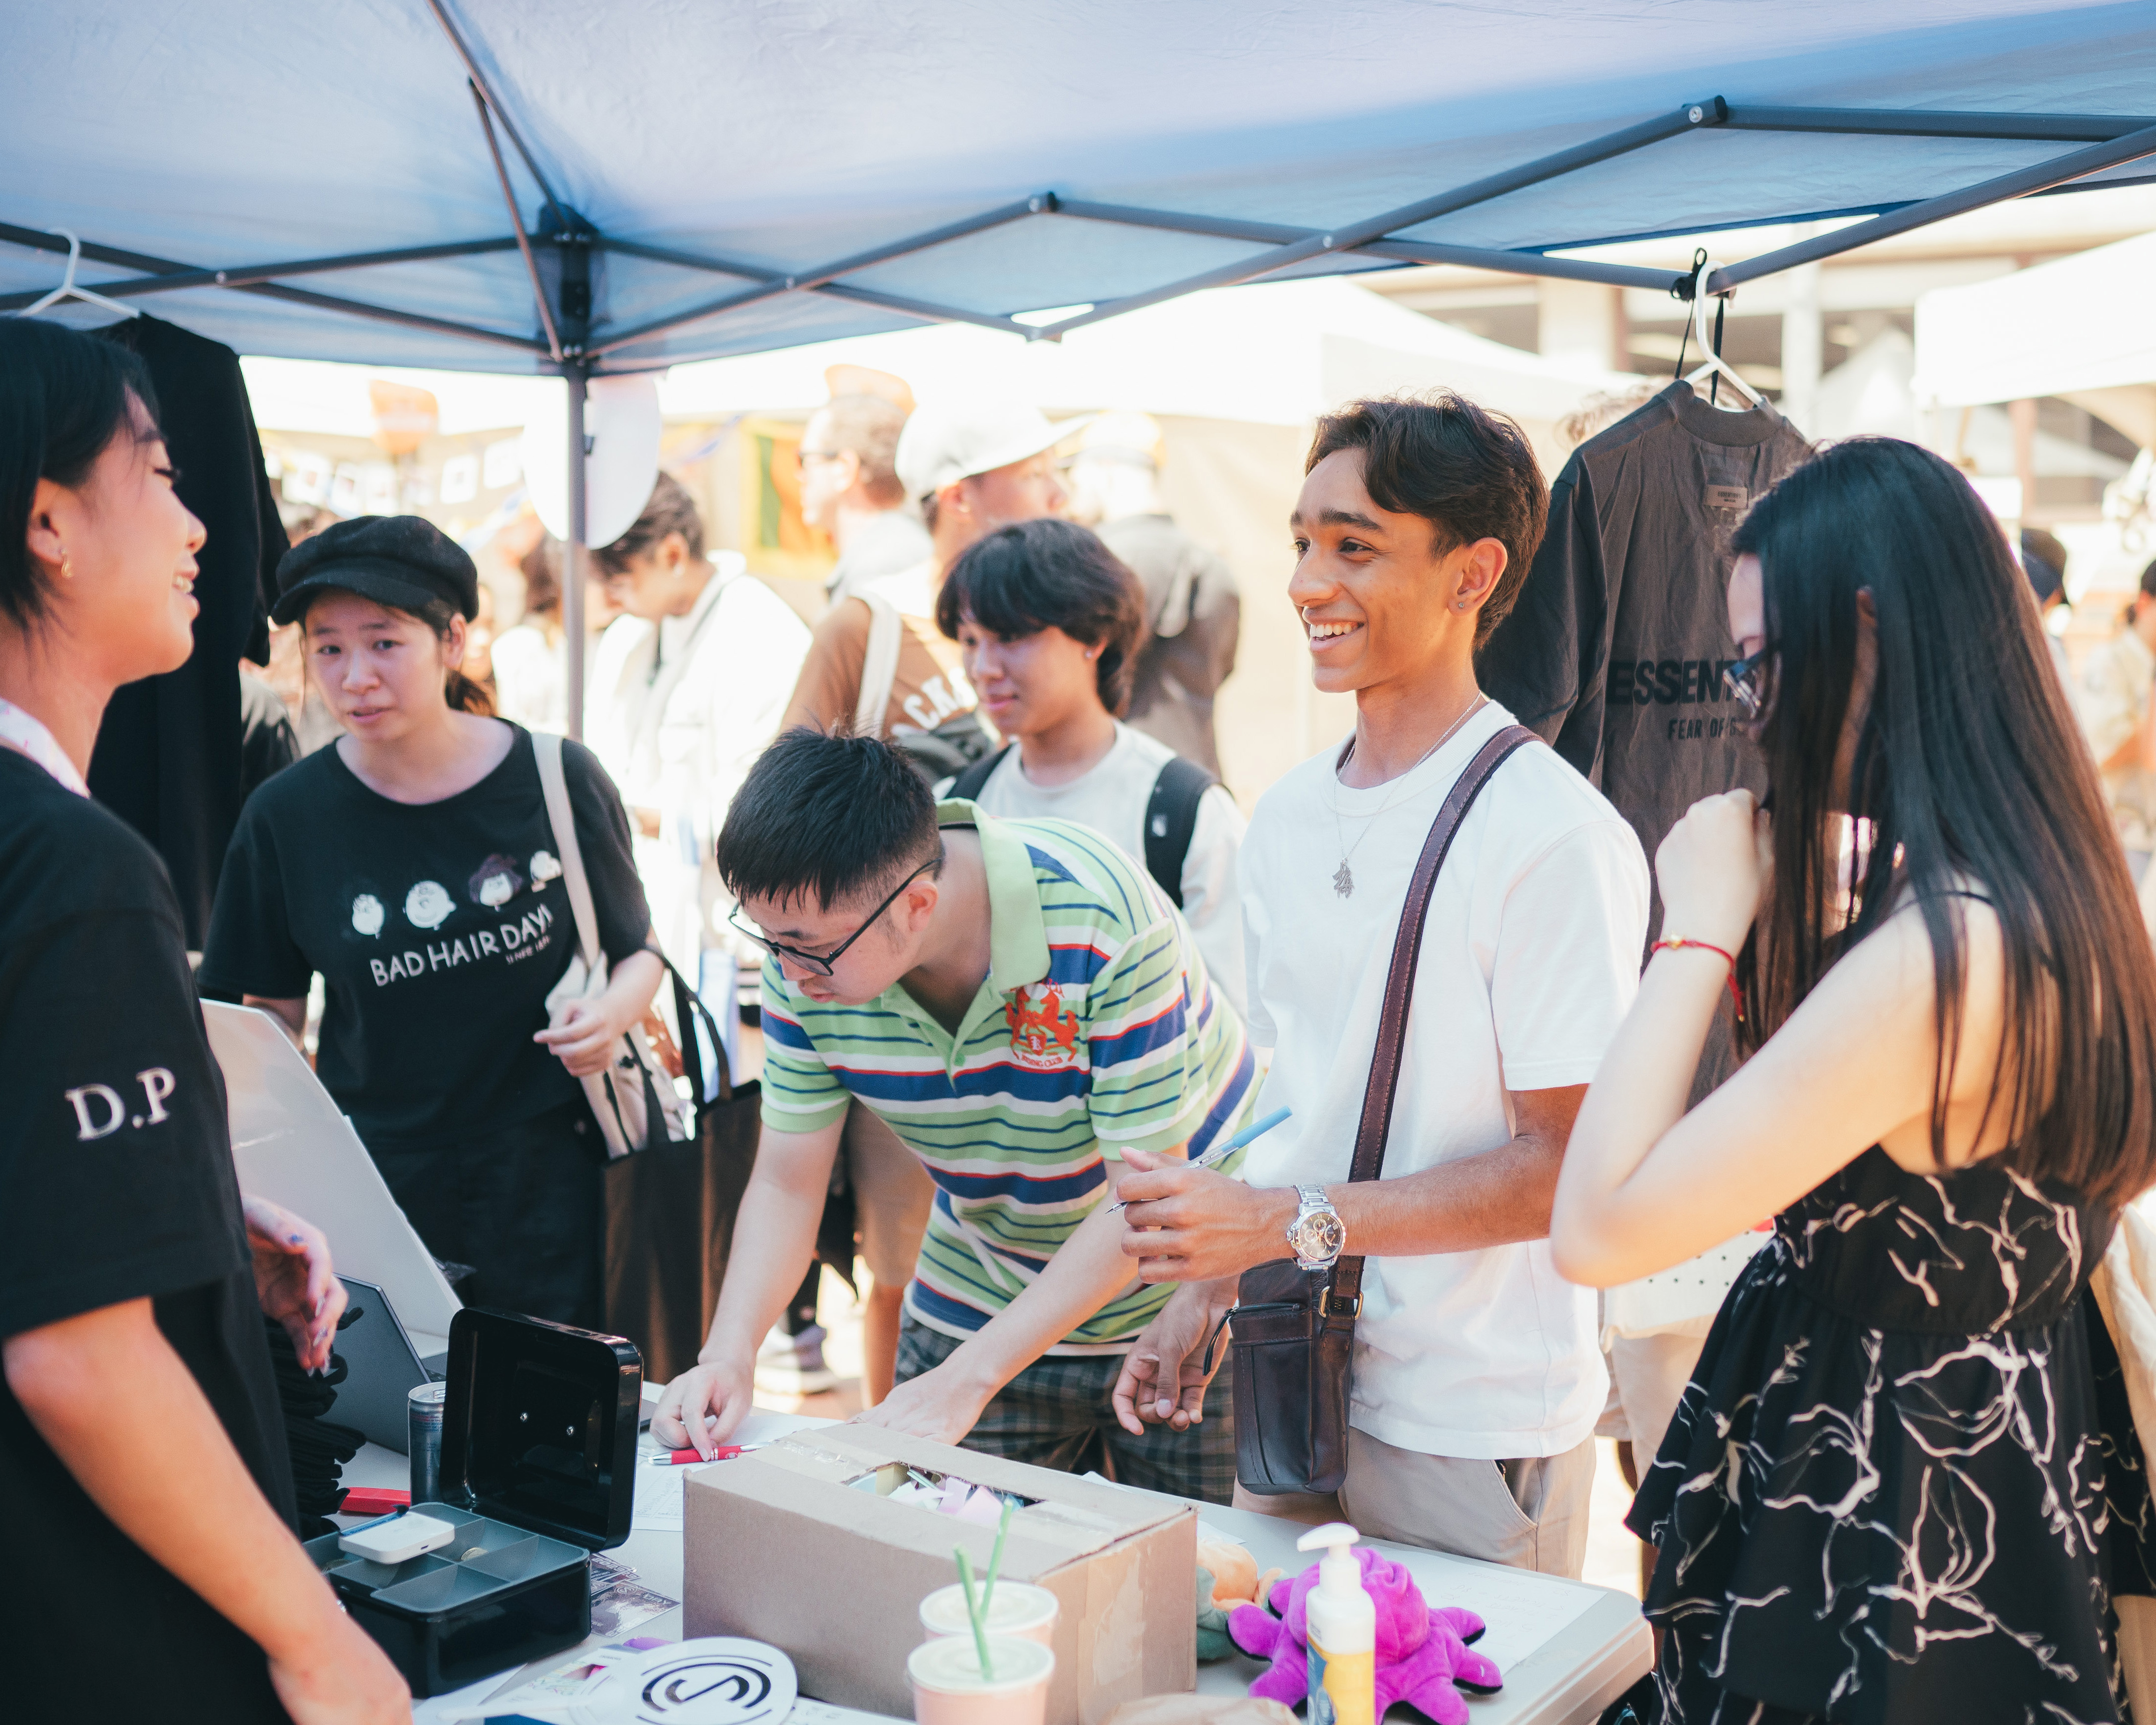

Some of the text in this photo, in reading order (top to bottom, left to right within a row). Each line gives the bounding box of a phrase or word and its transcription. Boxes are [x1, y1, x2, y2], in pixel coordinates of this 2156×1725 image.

[1667, 718, 1702, 740] FEAR
[370, 951, 425, 987] BAD
[427, 930, 501, 972] HAIR
[64, 1066, 176, 1142] D.P
